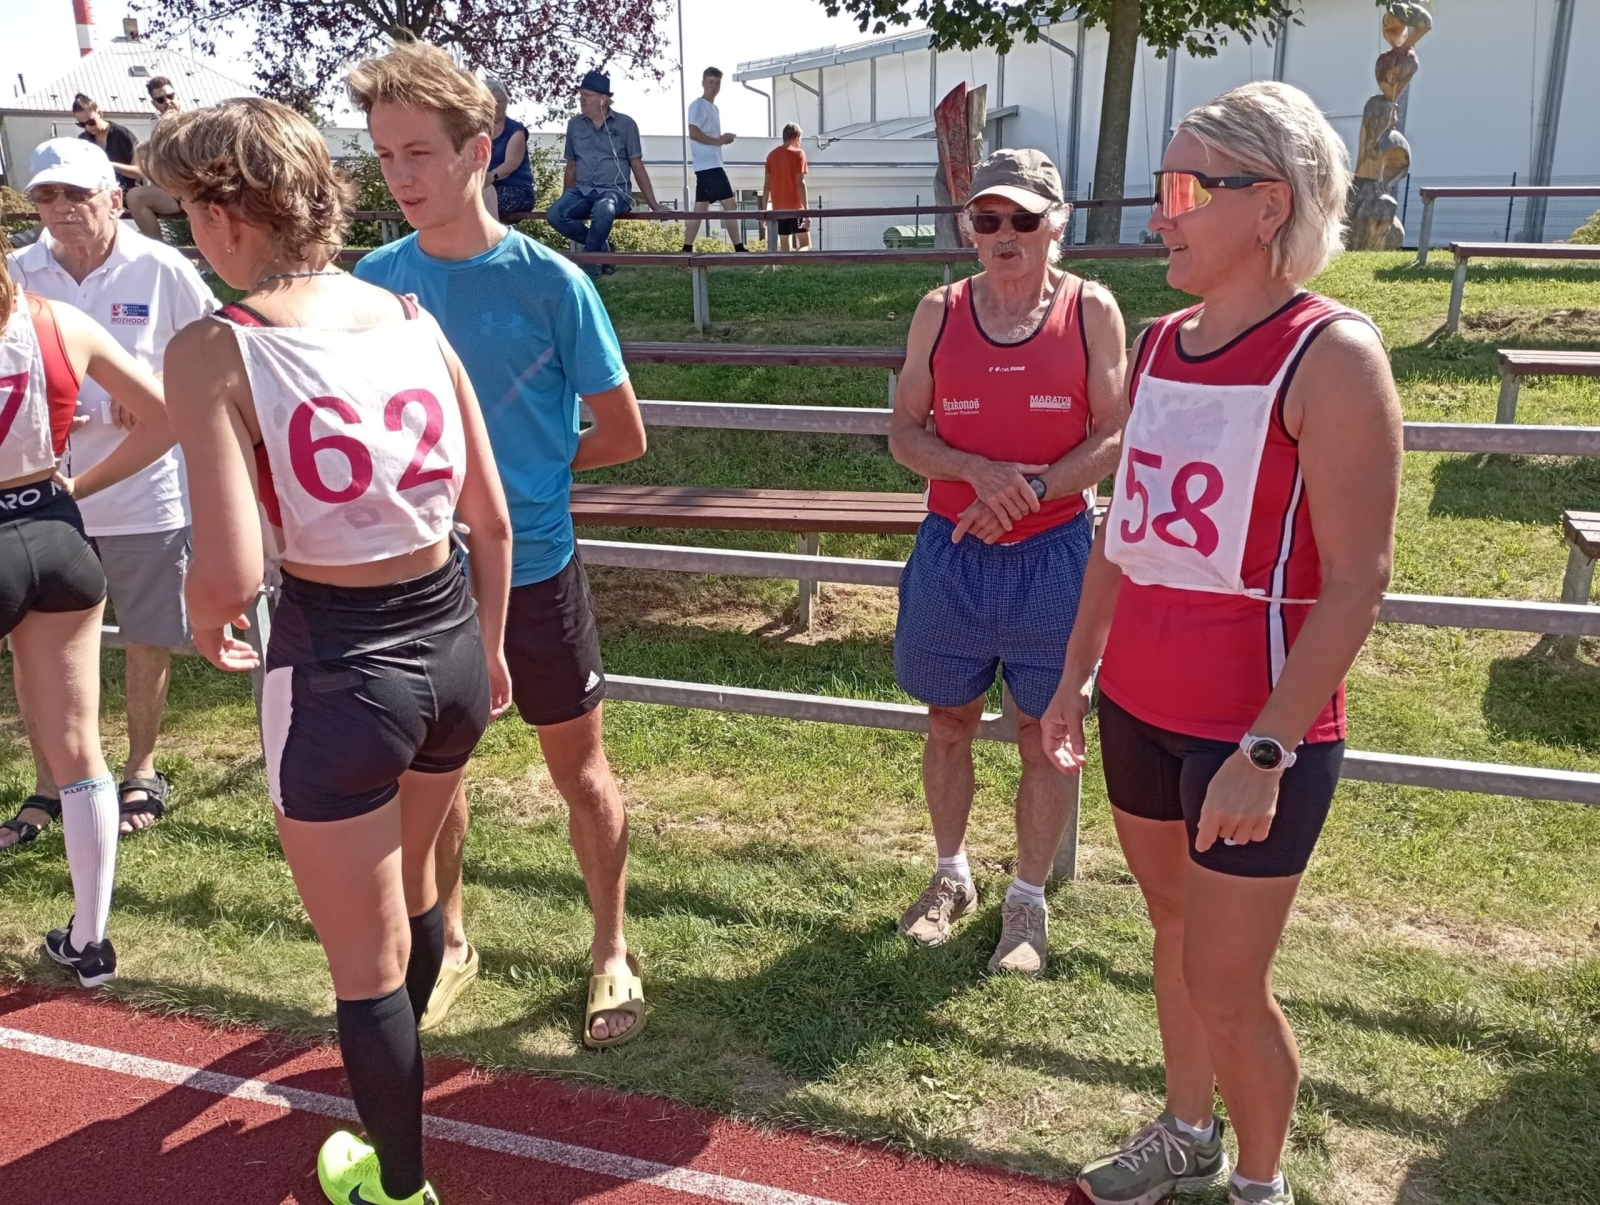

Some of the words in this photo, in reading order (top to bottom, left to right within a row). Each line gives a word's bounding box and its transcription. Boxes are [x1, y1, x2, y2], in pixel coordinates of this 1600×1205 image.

[289, 388, 453, 504] 62
[1030, 395, 1072, 403] MARATON
[1121, 447, 1224, 558] 58
